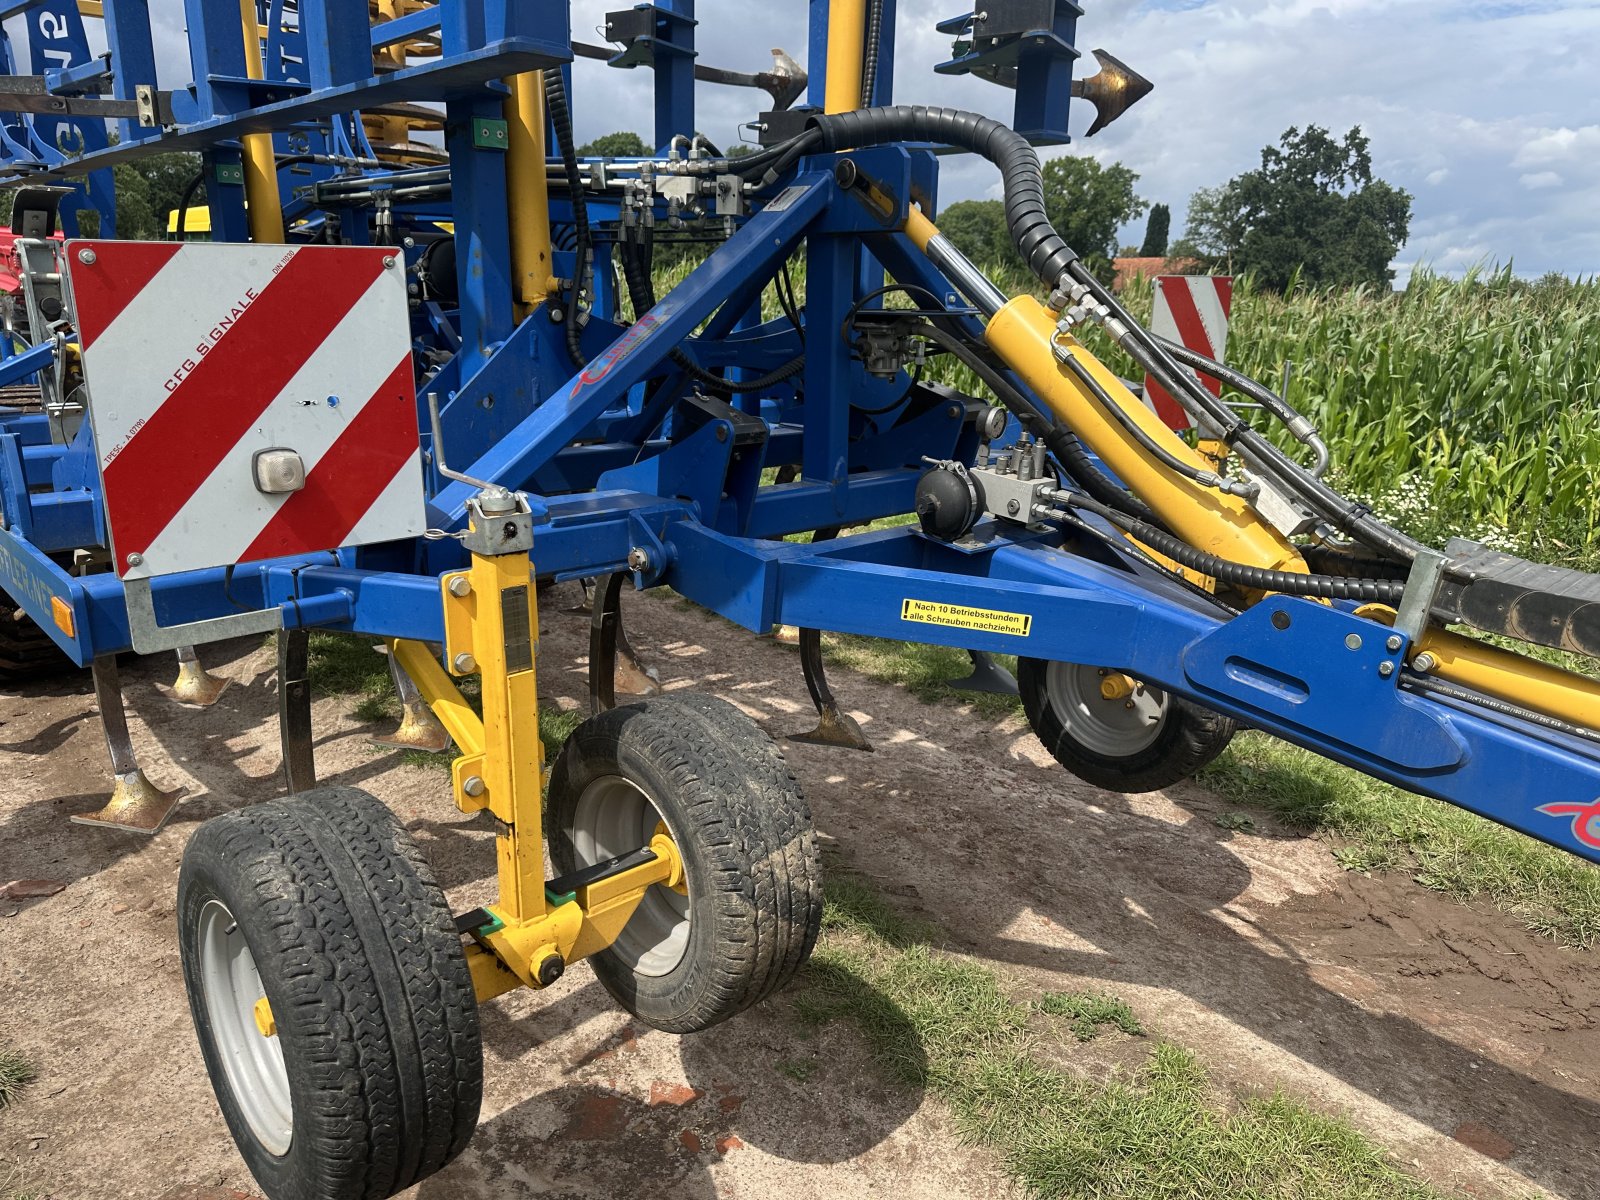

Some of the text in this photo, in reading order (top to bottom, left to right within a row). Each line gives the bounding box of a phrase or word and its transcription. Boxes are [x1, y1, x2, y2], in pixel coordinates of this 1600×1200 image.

[272, 263, 283, 274] DIN
[164, 358, 196, 392] CFG
[909, 612, 1021, 634] alle Schrauben nachziehen
[914, 602, 1020, 623] Nach 10 Betriebsstunden
